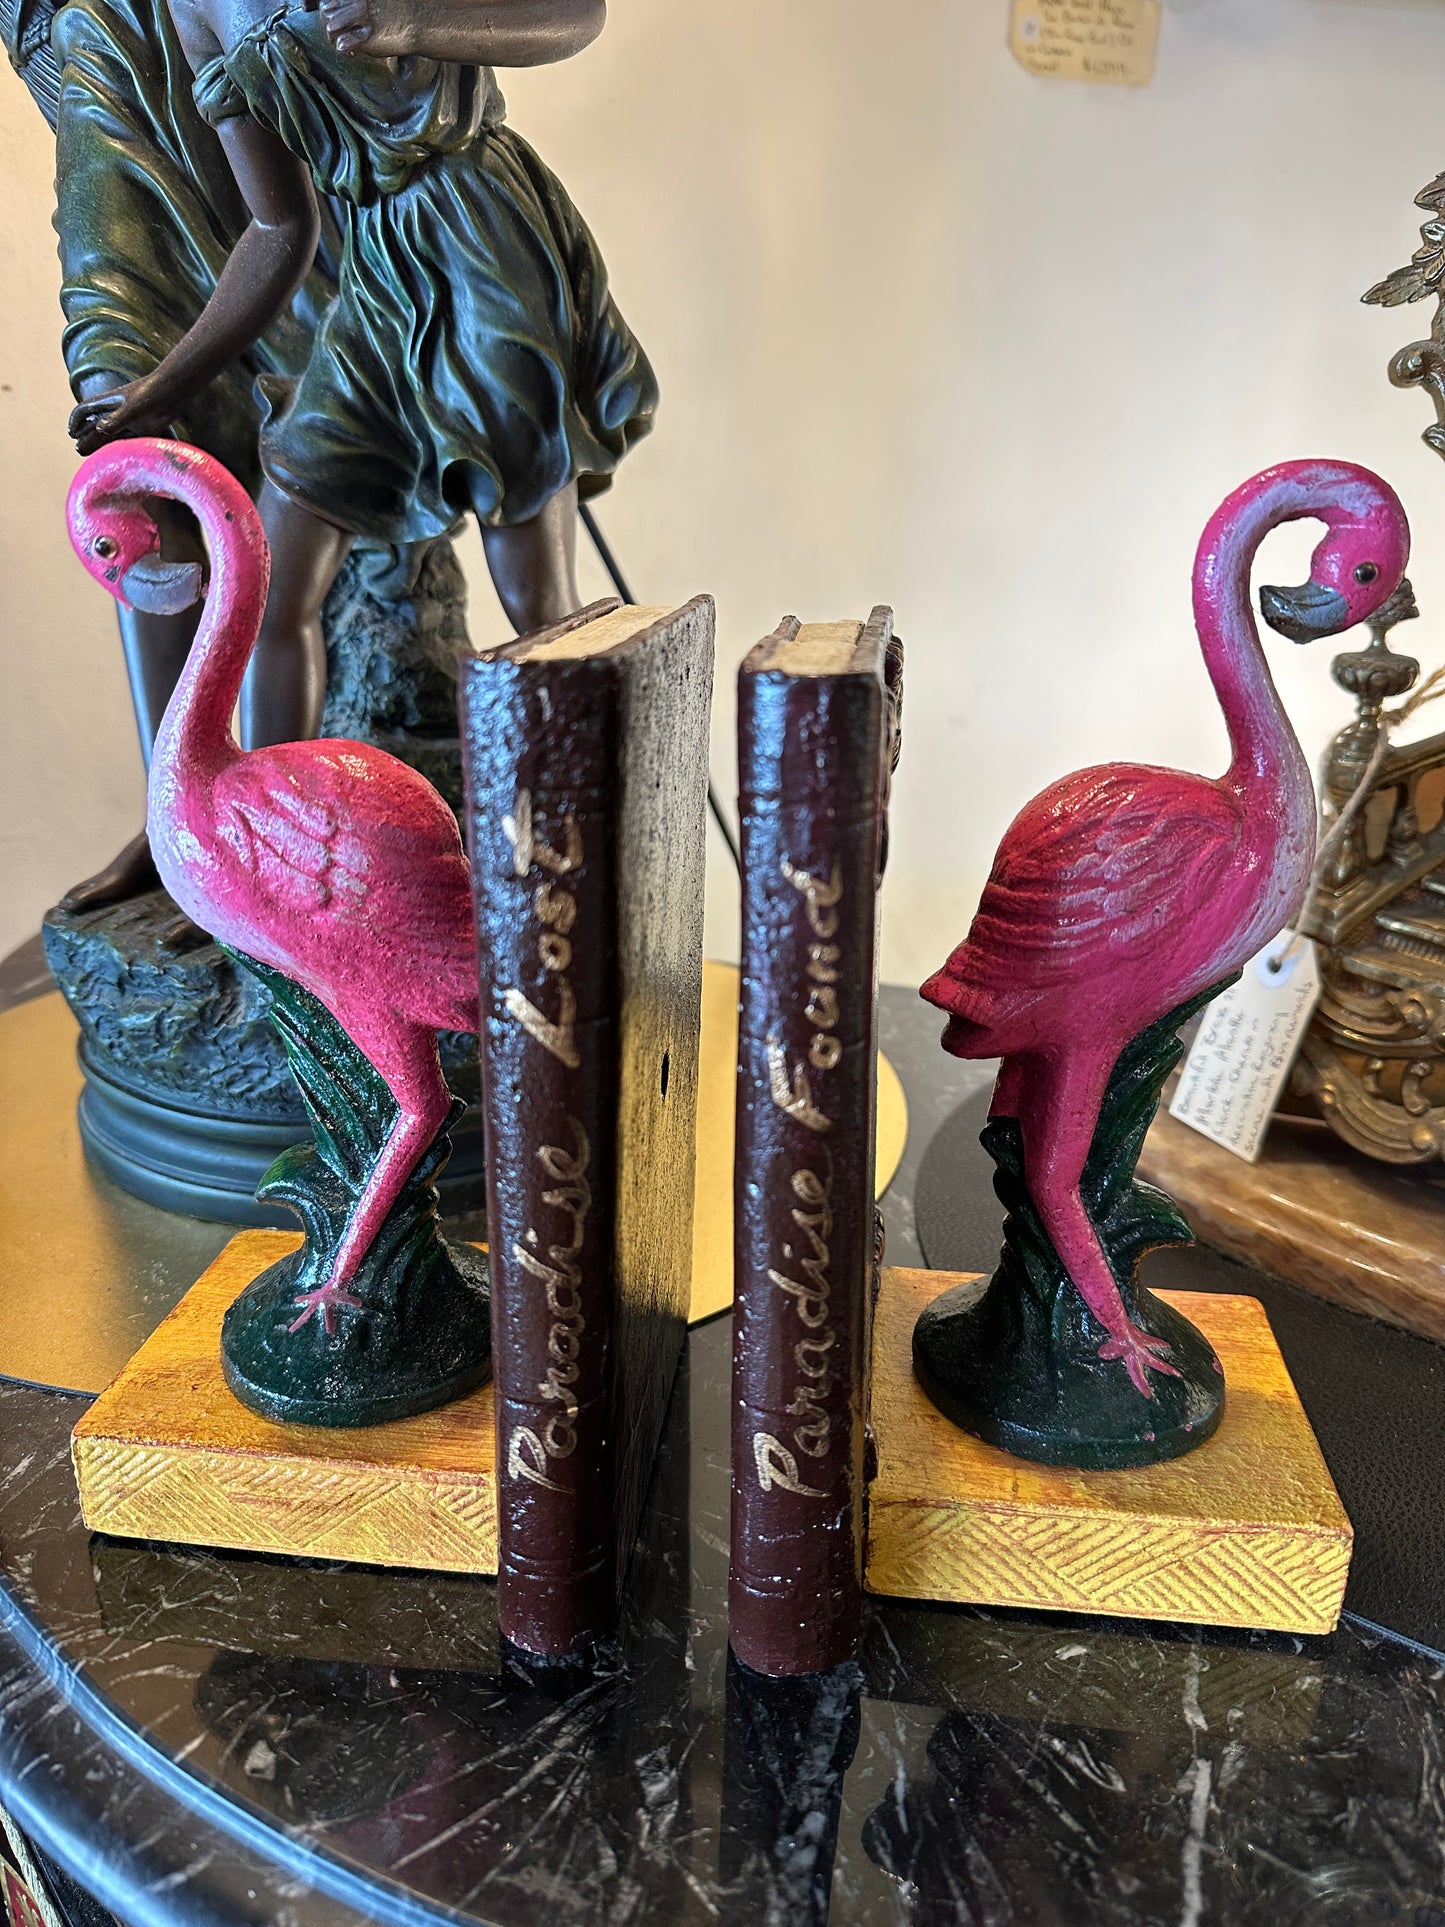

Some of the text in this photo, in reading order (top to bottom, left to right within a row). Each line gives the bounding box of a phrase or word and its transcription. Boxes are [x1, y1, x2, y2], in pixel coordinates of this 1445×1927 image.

[501, 788, 592, 1492] Paradise Lost
[753, 853, 844, 1498] Paradise Found
